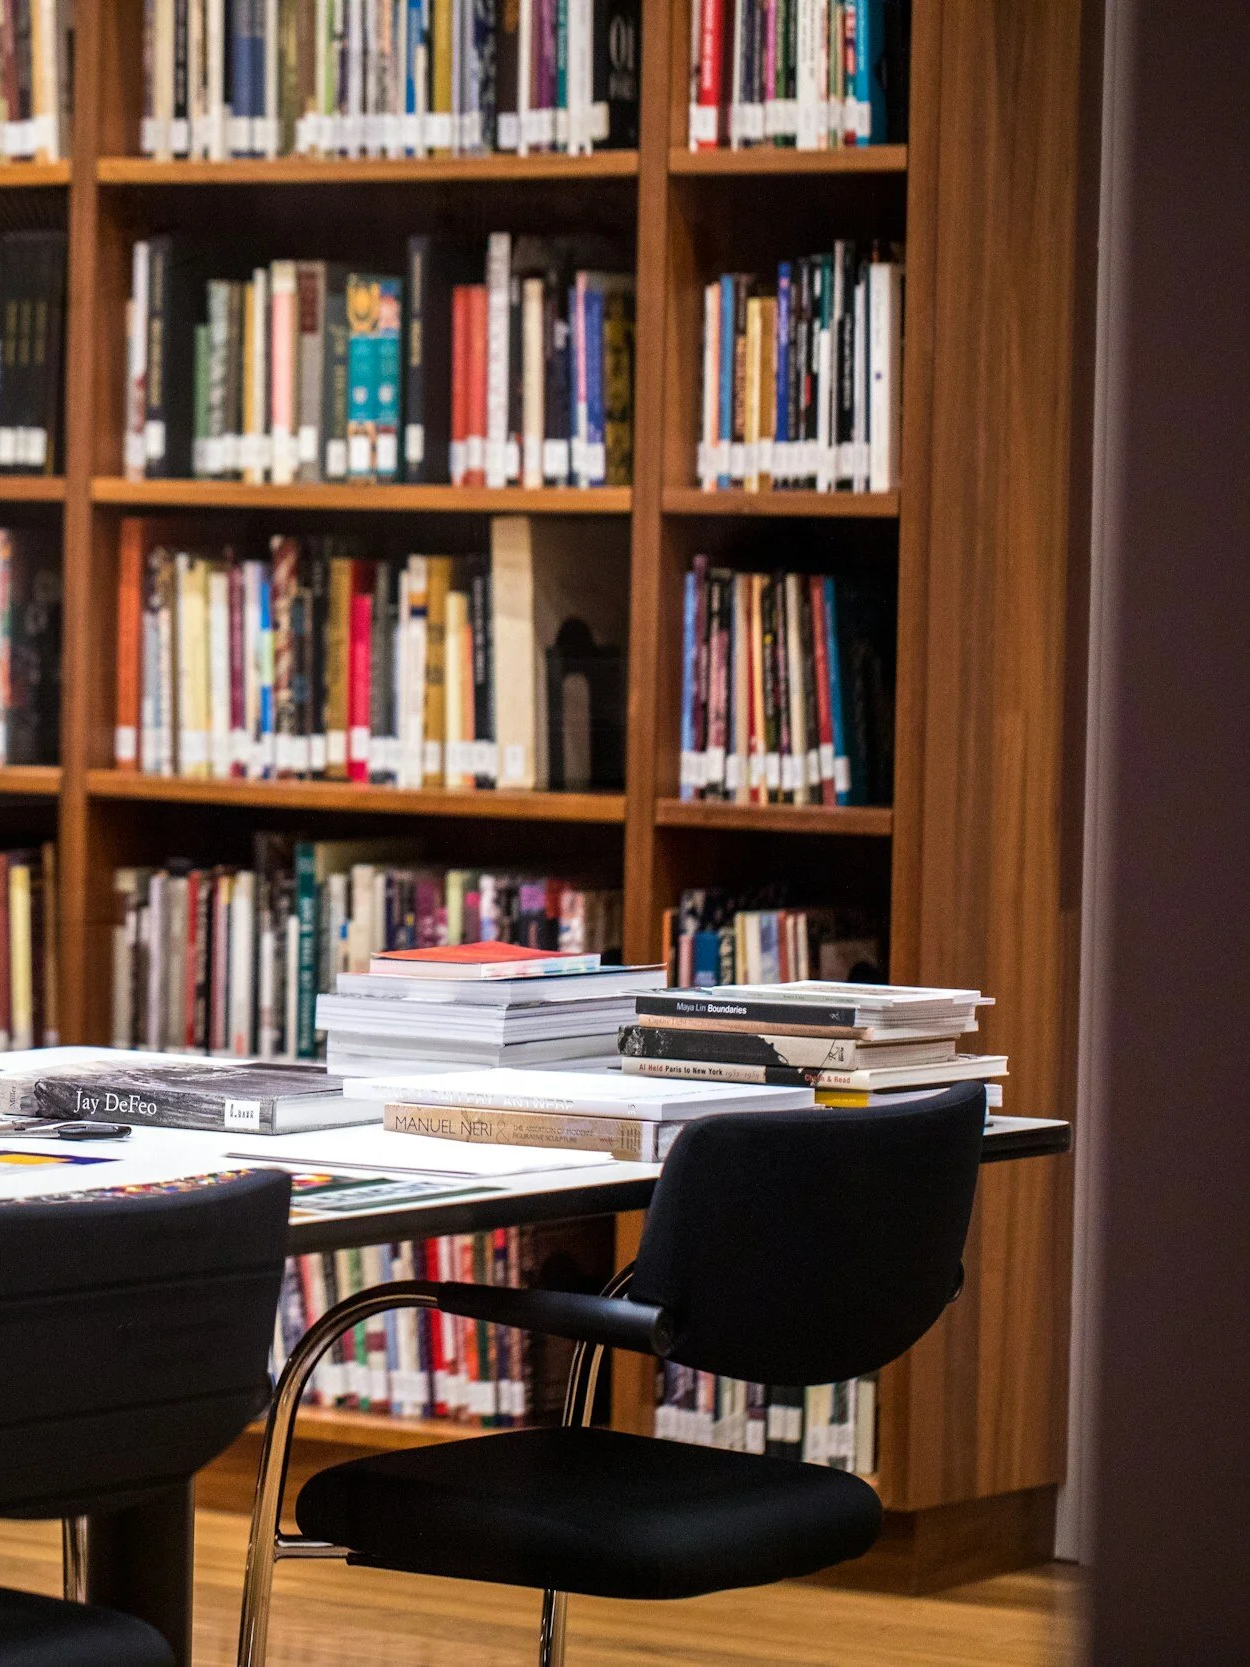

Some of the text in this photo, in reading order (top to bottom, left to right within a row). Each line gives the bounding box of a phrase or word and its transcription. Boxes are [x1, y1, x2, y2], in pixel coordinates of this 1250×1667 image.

[676, 1002, 748, 1015] Maya Lin Boundaries
[639, 1063, 646, 1071] Al
[648, 1064, 663, 1072] Held
[665, 1065, 682, 1074] Paris
[684, 1066, 691, 1074] to
[692, 1067, 706, 1075] New
[708, 1067, 723, 1076] York
[834, 1075, 851, 1084] Read
[73, 1090, 158, 1115] Jay DeFeo
[502, 1095, 575, 1110] ANTWERP
[395, 1115, 456, 1135] MANUEL
[460, 1119, 492, 1137] NERI
